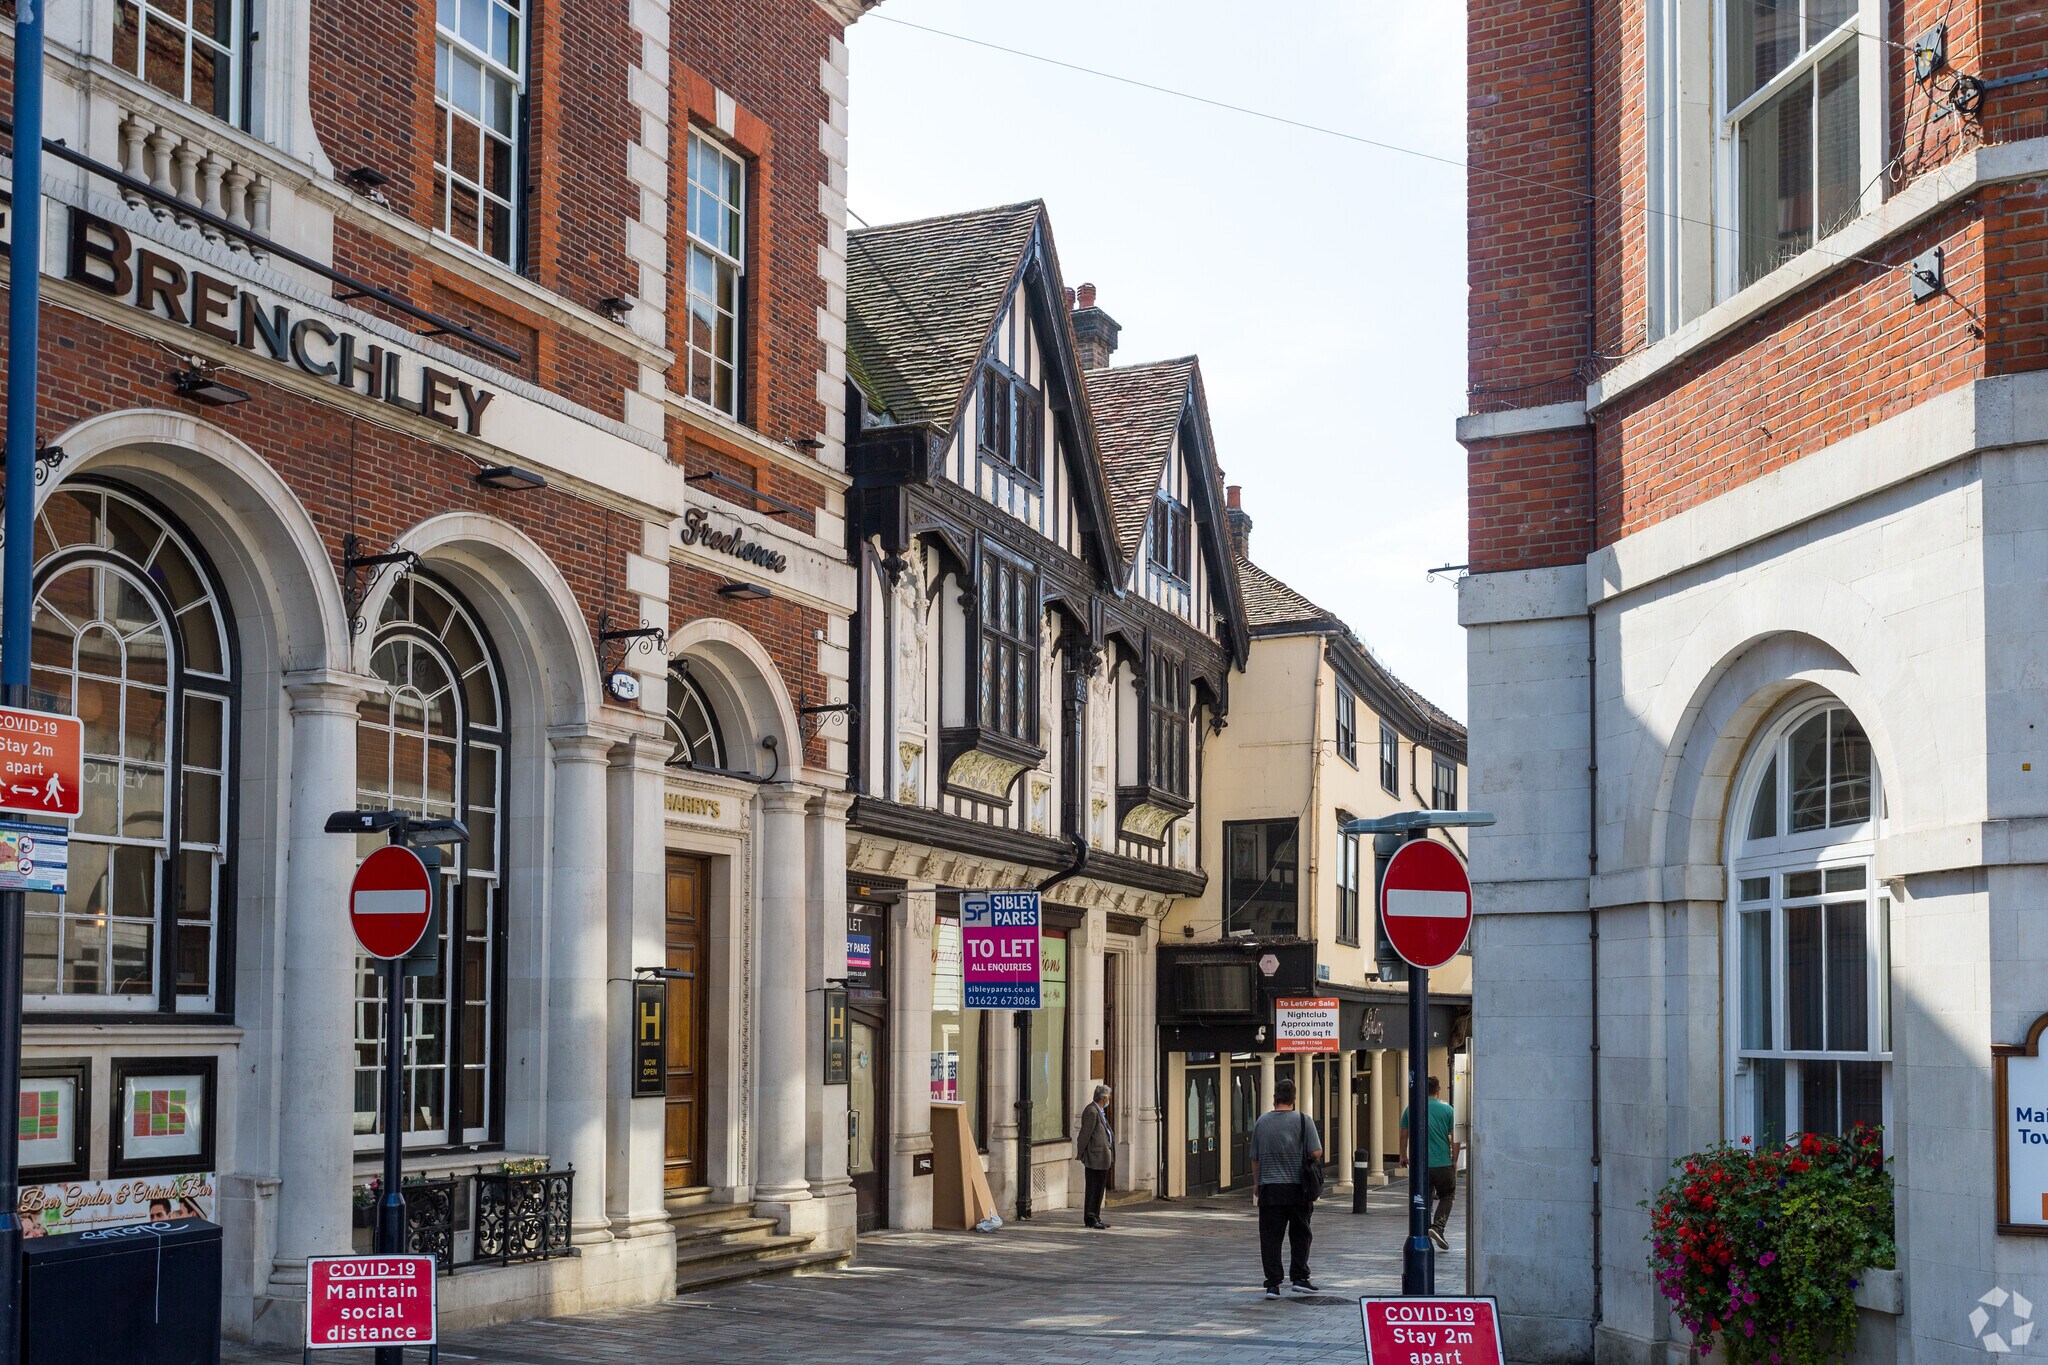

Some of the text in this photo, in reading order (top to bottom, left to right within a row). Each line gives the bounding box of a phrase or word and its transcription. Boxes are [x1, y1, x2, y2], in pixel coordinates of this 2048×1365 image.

[65, 205, 495, 436] BRENCHLEY
[681, 508, 787, 574] Freehouse
[0, 737, 54, 757] Stay 2m
[6, 761, 44, 775] apart
[664, 792, 721, 819] HARRY'S
[994, 896, 1036, 910] SIBLEY
[848, 918, 862, 931] LET
[995, 911, 1036, 926] PARES
[854, 943, 870, 953] PARES
[967, 939, 1034, 958] TO LET
[972, 963, 1032, 973] ALL ENQUIRIES
[968, 986, 1035, 994] sibleypares.co.uk
[969, 996, 1037, 1005] 01622 673086
[641, 1002, 660, 1039] H
[830, 1007, 844, 1037] H
[1287, 1011, 1328, 1019] Nightclub
[1281, 1020, 1334, 1028] Approximate
[20, 1177, 212, 1217] Beer Garden & Outside Bar
[329, 1262, 416, 1277] COVID-19
[326, 1282, 418, 1300] Maintain
[340, 1302, 404, 1320] social
[1385, 1306, 1475, 1322] COVID-19
[326, 1324, 417, 1341] distance
[1393, 1328, 1473, 1347] Stay 2m
[1409, 1349, 1463, 1365] apart
